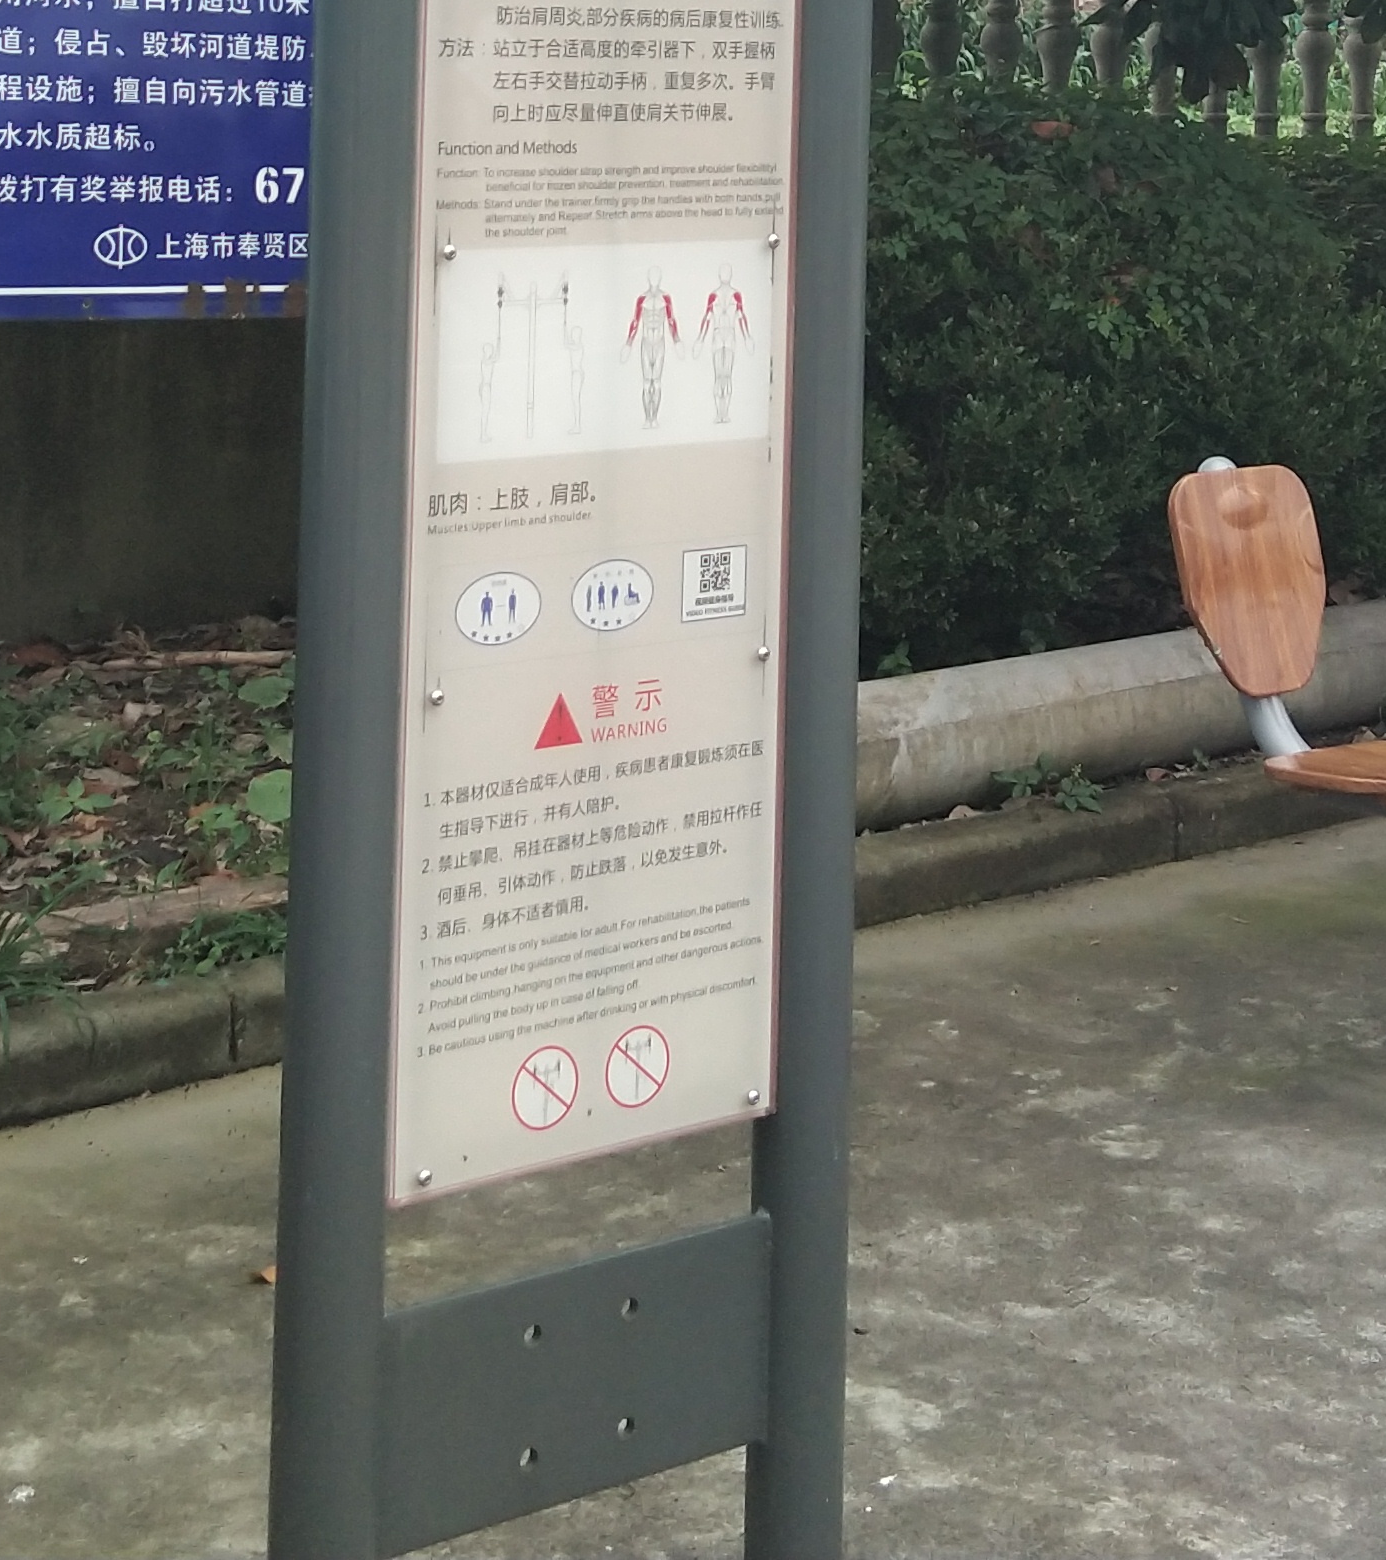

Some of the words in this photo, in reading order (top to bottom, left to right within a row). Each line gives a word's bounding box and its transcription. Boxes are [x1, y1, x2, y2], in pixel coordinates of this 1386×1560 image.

[438, 141, 492, 155] Function
[495, 140, 519, 155] and
[522, 140, 578, 155] Methods
[484, 198, 513, 209] Stand
[515, 198, 542, 209] under
[544, 197, 560, 208] the
[641, 194, 655, 205] the
[538, 211, 556, 222] and
[684, 207, 698, 218] the
[700, 206, 722, 217] head
[485, 227, 500, 238] the
[502, 226, 544, 237] shoulder
[427, 480, 596, 517] 肌肉：上肢，肩部。
[504, 515, 526, 528] limb
[528, 513, 547, 525] and
[592, 678, 662, 719] 警示
[591, 717, 667, 743] WARNING
[431, 956, 452, 968] This
[455, 945, 507, 963] equipment
[518, 938, 539, 951] only
[541, 931, 578, 946] suitable
[580, 927, 593, 938] for
[715, 896, 751, 913] patients
[429, 974, 463, 990] should
[465, 972, 478, 983] be
[480, 965, 508, 980] under
[510, 962, 526, 973] the
[527, 954, 572, 973] guidance
[573, 949, 583, 961] of
[585, 942, 621, 958] medical
[623, 935, 659, 951] workers
[660, 931, 678, 943] and
[680, 928, 691, 939] be
[429, 995, 468, 1011] Prohibit
[554, 976, 567, 985] on
[568, 971, 583, 982] the
[585, 959, 635, 980] equipment
[636, 957, 653, 968] and
[655, 951, 678, 964] other
[680, 943, 729, 960] dangerous
[428, 1017, 457, 1034] Avoid
[458, 1011, 491, 1029] pulling
[493, 1008, 509, 1020] the
[510, 1002, 534, 1016] body
[536, 1000, 549, 1011] up
[550, 997, 559, 1007] in
[560, 994, 584, 1005] case
[585, 988, 594, 999] of
[596, 982, 625, 997] falling
[428, 1043, 443, 1055] Be
[444, 1035, 487, 1051] cautious
[488, 1028, 515, 1042] using
[516, 1024, 532, 1036] the
[534, 1017, 575, 1032] machine
[576, 1011, 598, 1024] after
[600, 1002, 637, 1018] drinking
[638, 1000, 648, 1010] or
[650, 995, 669, 1007] with
[670, 986, 708, 1005] physical
